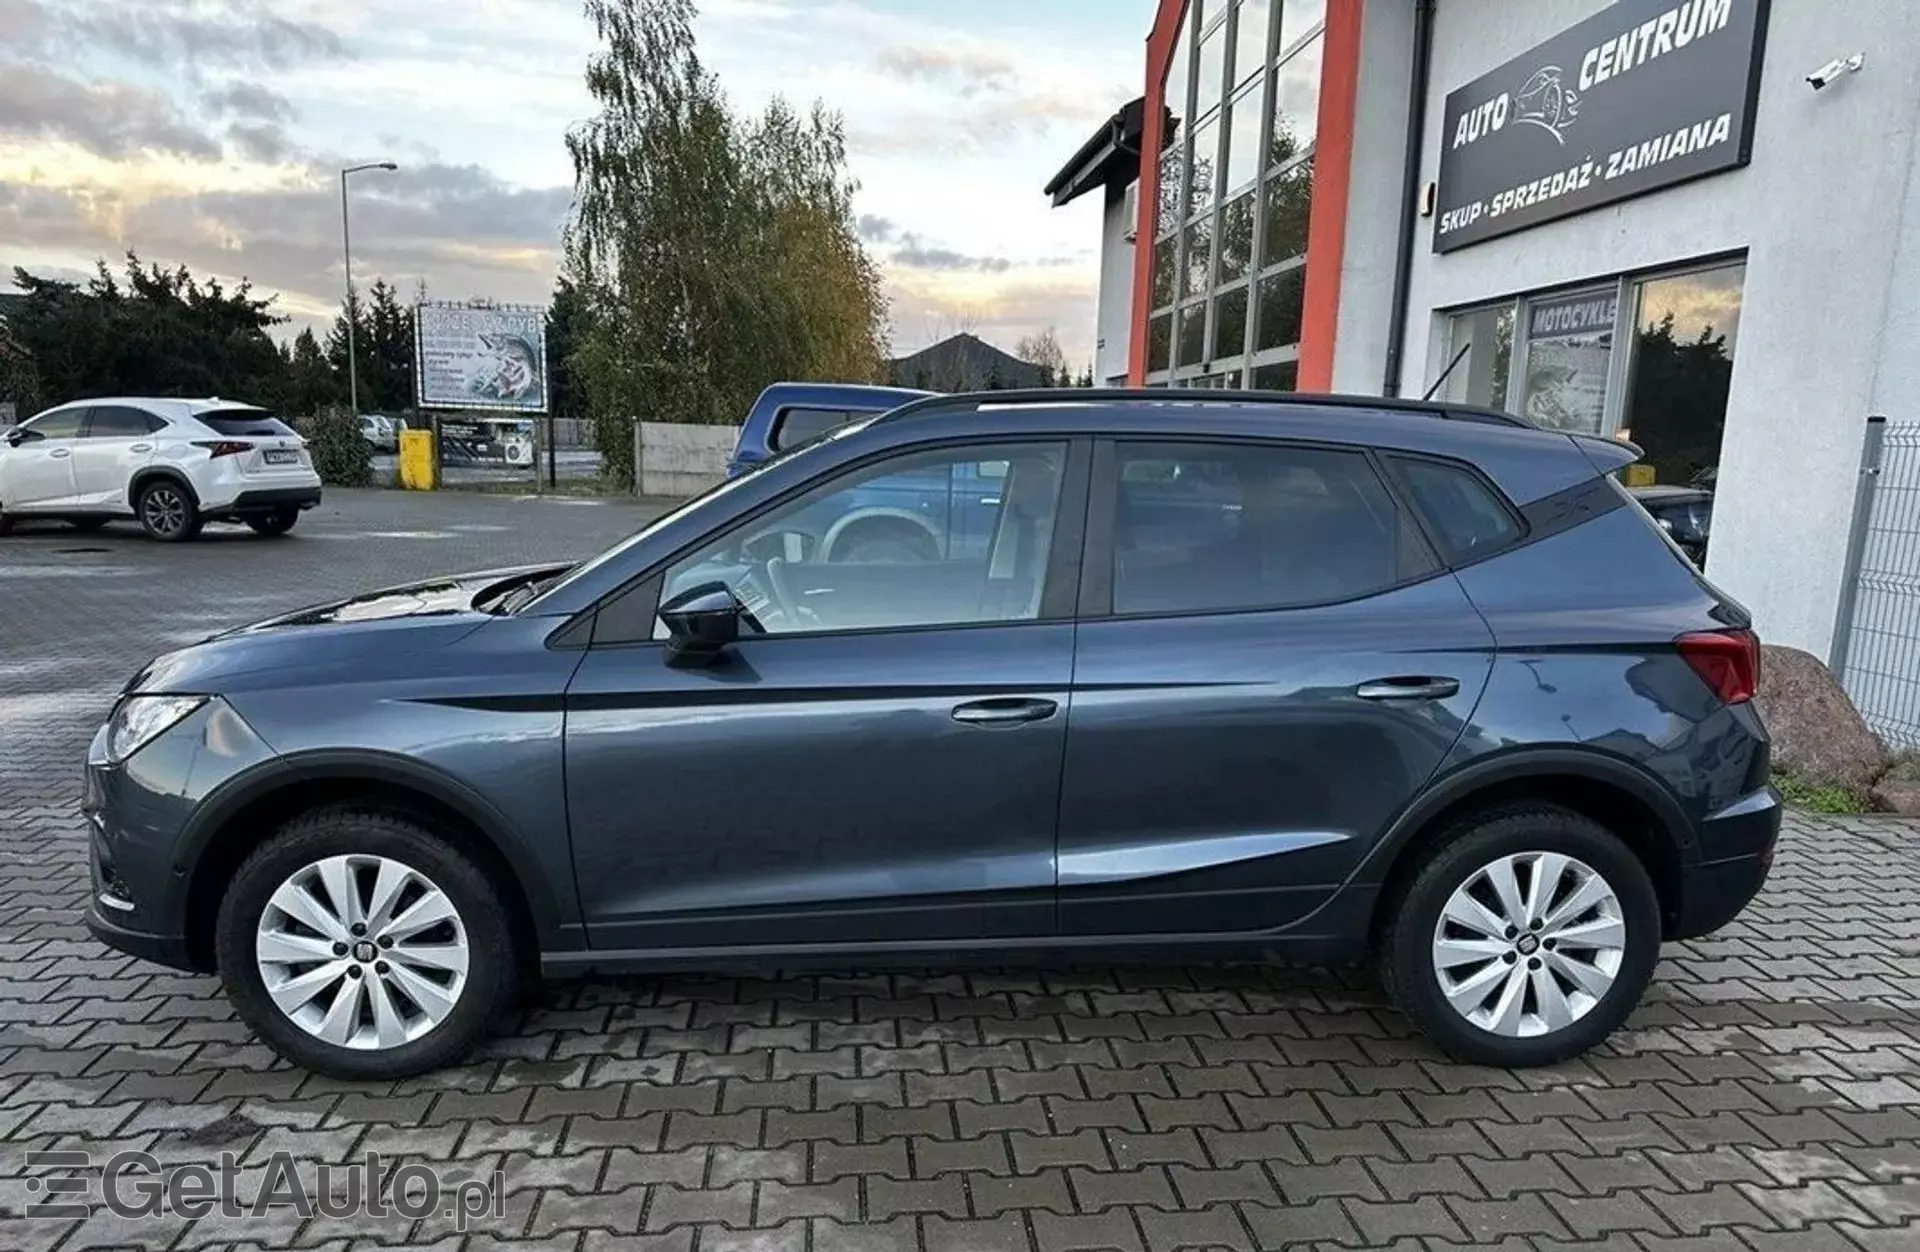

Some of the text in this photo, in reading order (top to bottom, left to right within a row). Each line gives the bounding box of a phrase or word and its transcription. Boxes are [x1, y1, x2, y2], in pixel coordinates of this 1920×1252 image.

[1453, 0, 1732, 149] AUTO CENTRUM
[1439, 205, 1482, 234] SKUP
[1604, 113, 1731, 180] ZAMIANA
